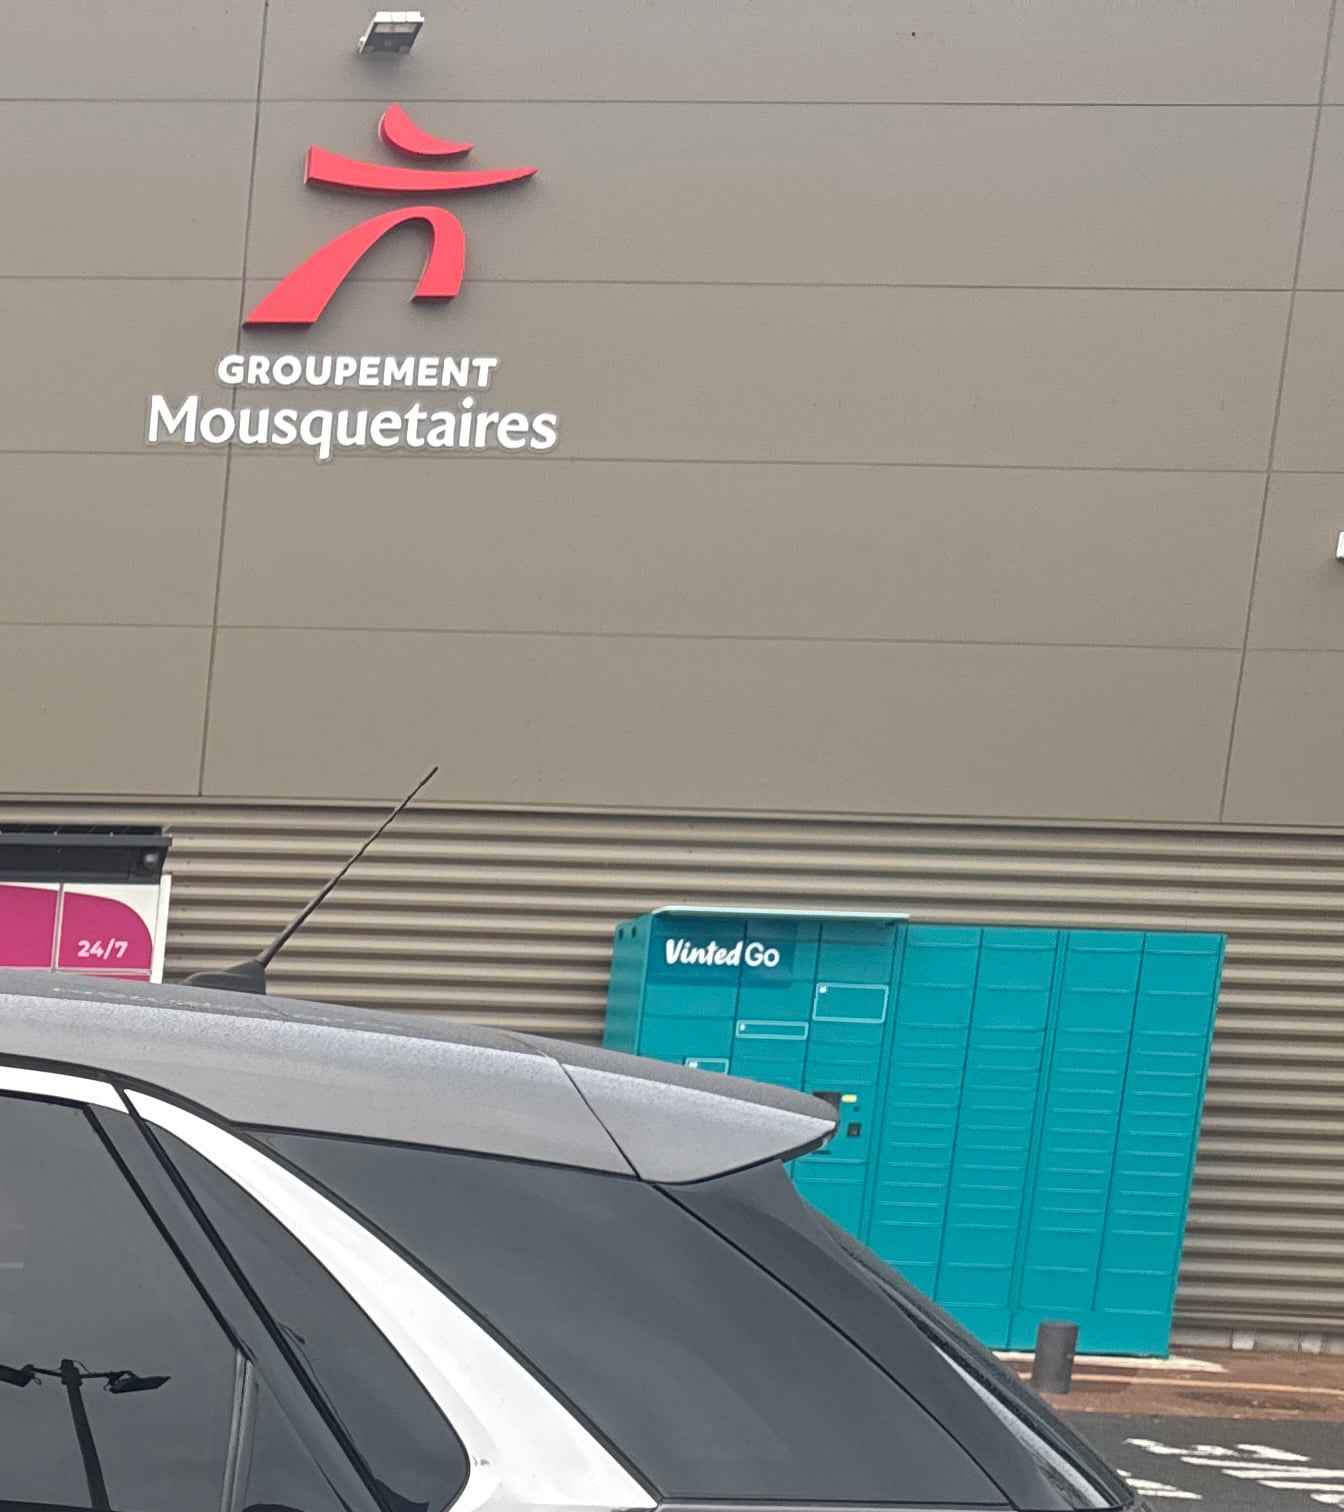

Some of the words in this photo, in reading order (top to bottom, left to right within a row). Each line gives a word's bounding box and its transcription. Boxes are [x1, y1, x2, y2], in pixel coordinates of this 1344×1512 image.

[218, 354, 498, 388] GROUPEMENT
[148, 395, 558, 460] Mousquetaires
[77, 938, 128, 960] 24/7
[665, 938, 743, 966] Vinted
[744, 942, 781, 967] Go
